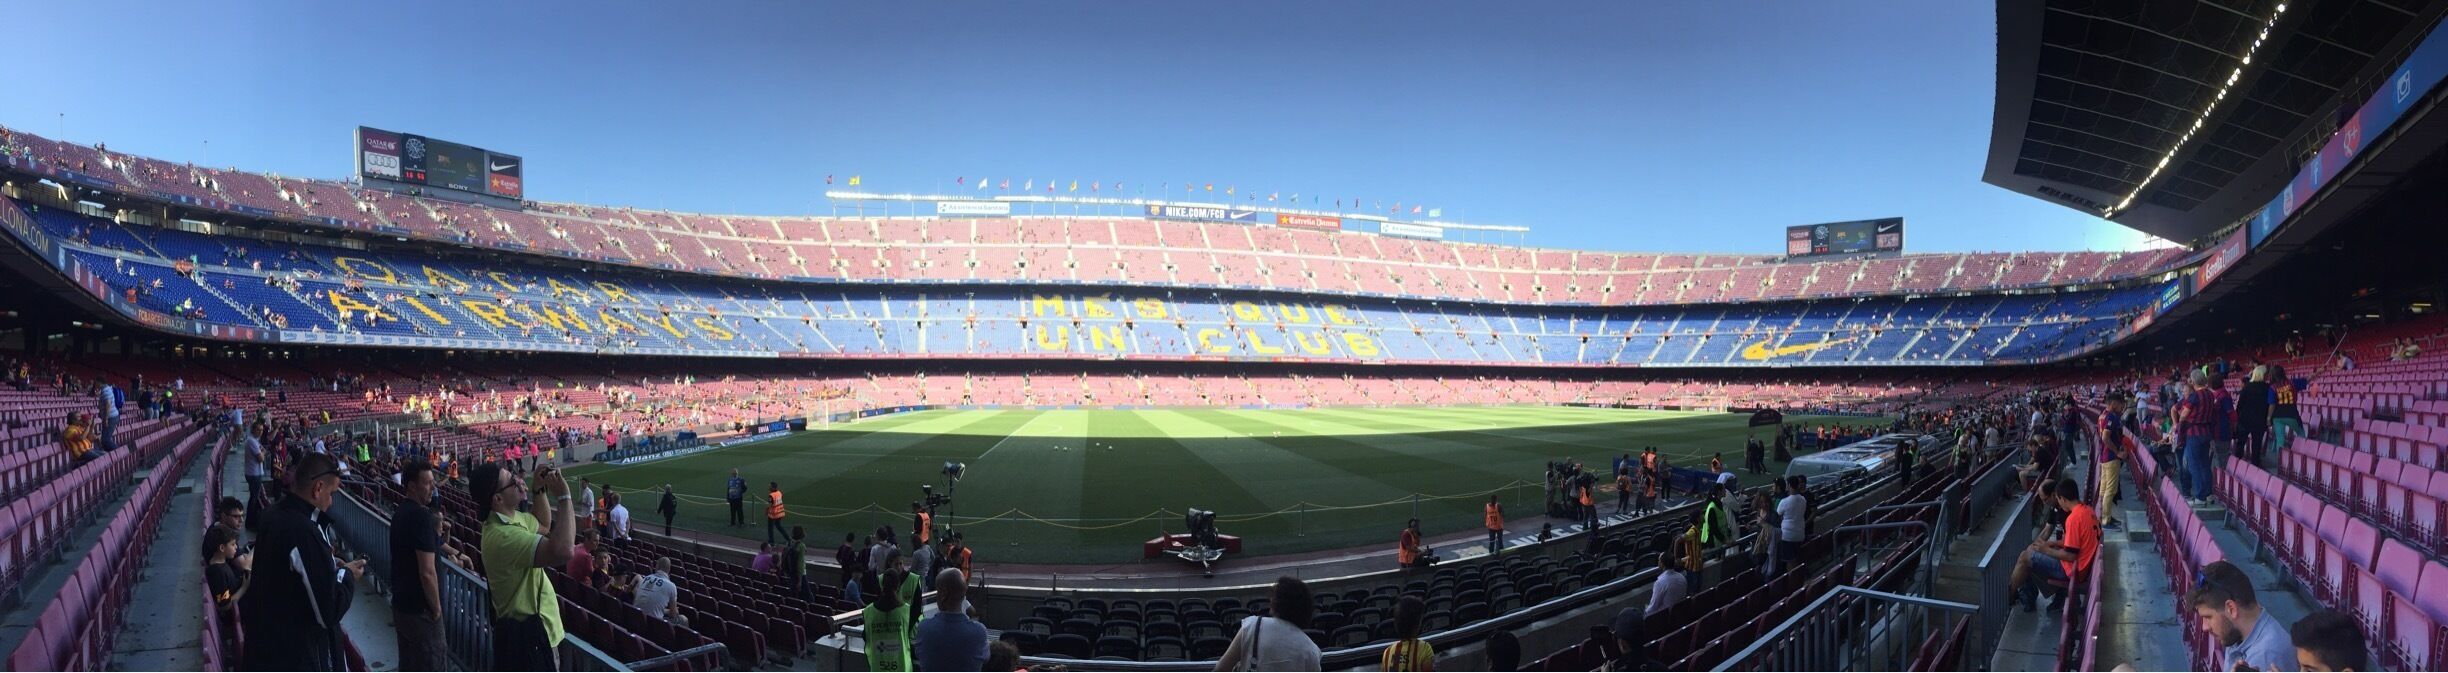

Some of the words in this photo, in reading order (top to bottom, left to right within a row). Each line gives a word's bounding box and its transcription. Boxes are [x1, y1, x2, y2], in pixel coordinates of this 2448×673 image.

[366, 138, 387, 146] QATAR
[448, 183, 468, 191] SONY
[1165, 206, 1225, 219] NIKE.COM/FCB
[0, 200, 49, 256] LONA.COM
[1289, 217, 1316, 226] Estrella
[1317, 219, 1339, 227] Damm
[1232, 301, 1356, 325] QUE
[138, 309, 187, 330] FCBARCELONA.CAT
[1036, 325, 1127, 351] UN
[1197, 328, 1379, 357] CLUB
[621, 452, 662, 464] Allianz
[642, 576, 664, 587] PJS
